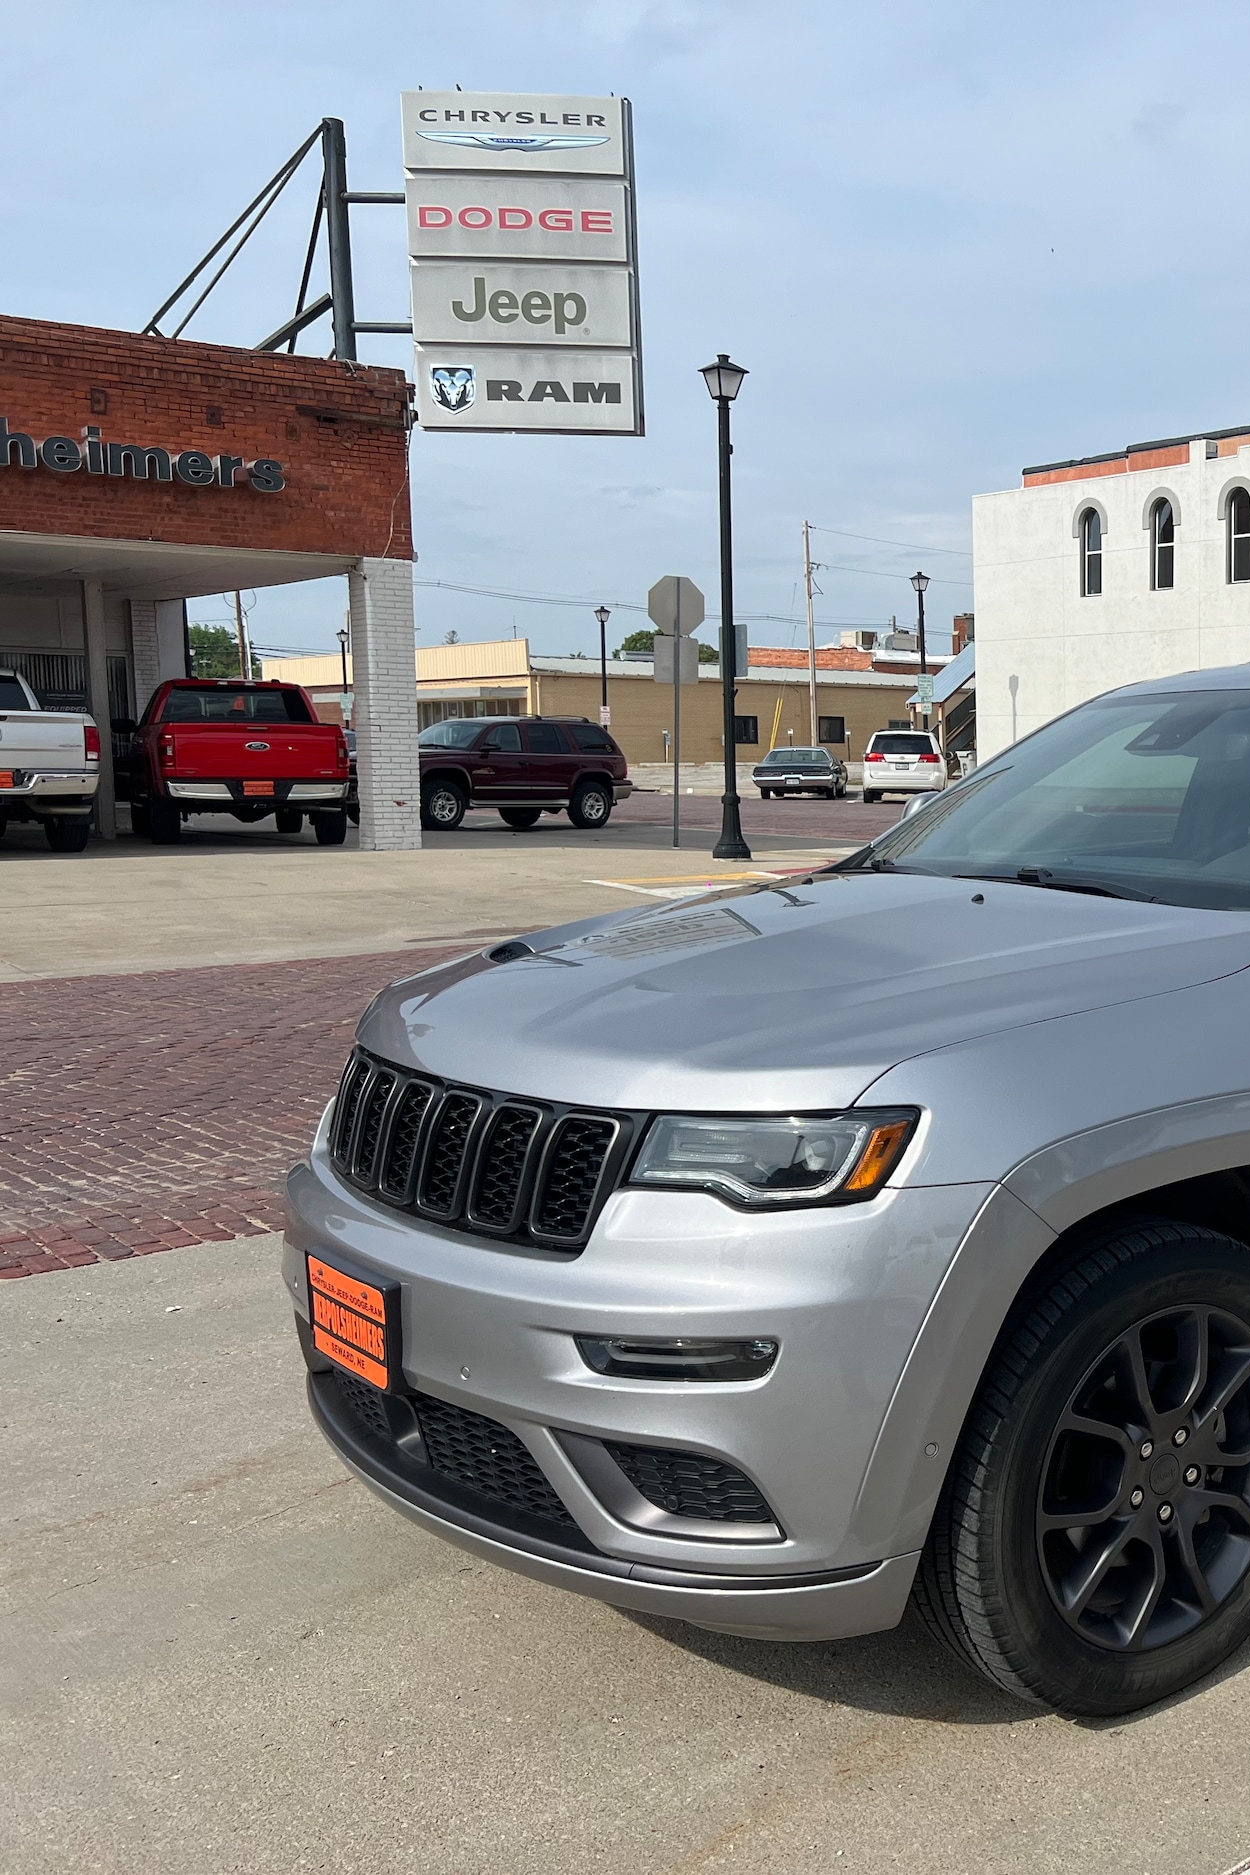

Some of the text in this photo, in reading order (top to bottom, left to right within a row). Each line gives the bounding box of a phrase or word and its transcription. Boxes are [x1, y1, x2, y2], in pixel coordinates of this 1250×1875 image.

[418, 109, 607, 127] CHRYSLER
[418, 206, 613, 233] DODGE
[452, 276, 587, 335] Jeep
[486, 379, 621, 404] RAM
[0, 416, 288, 493] heimers
